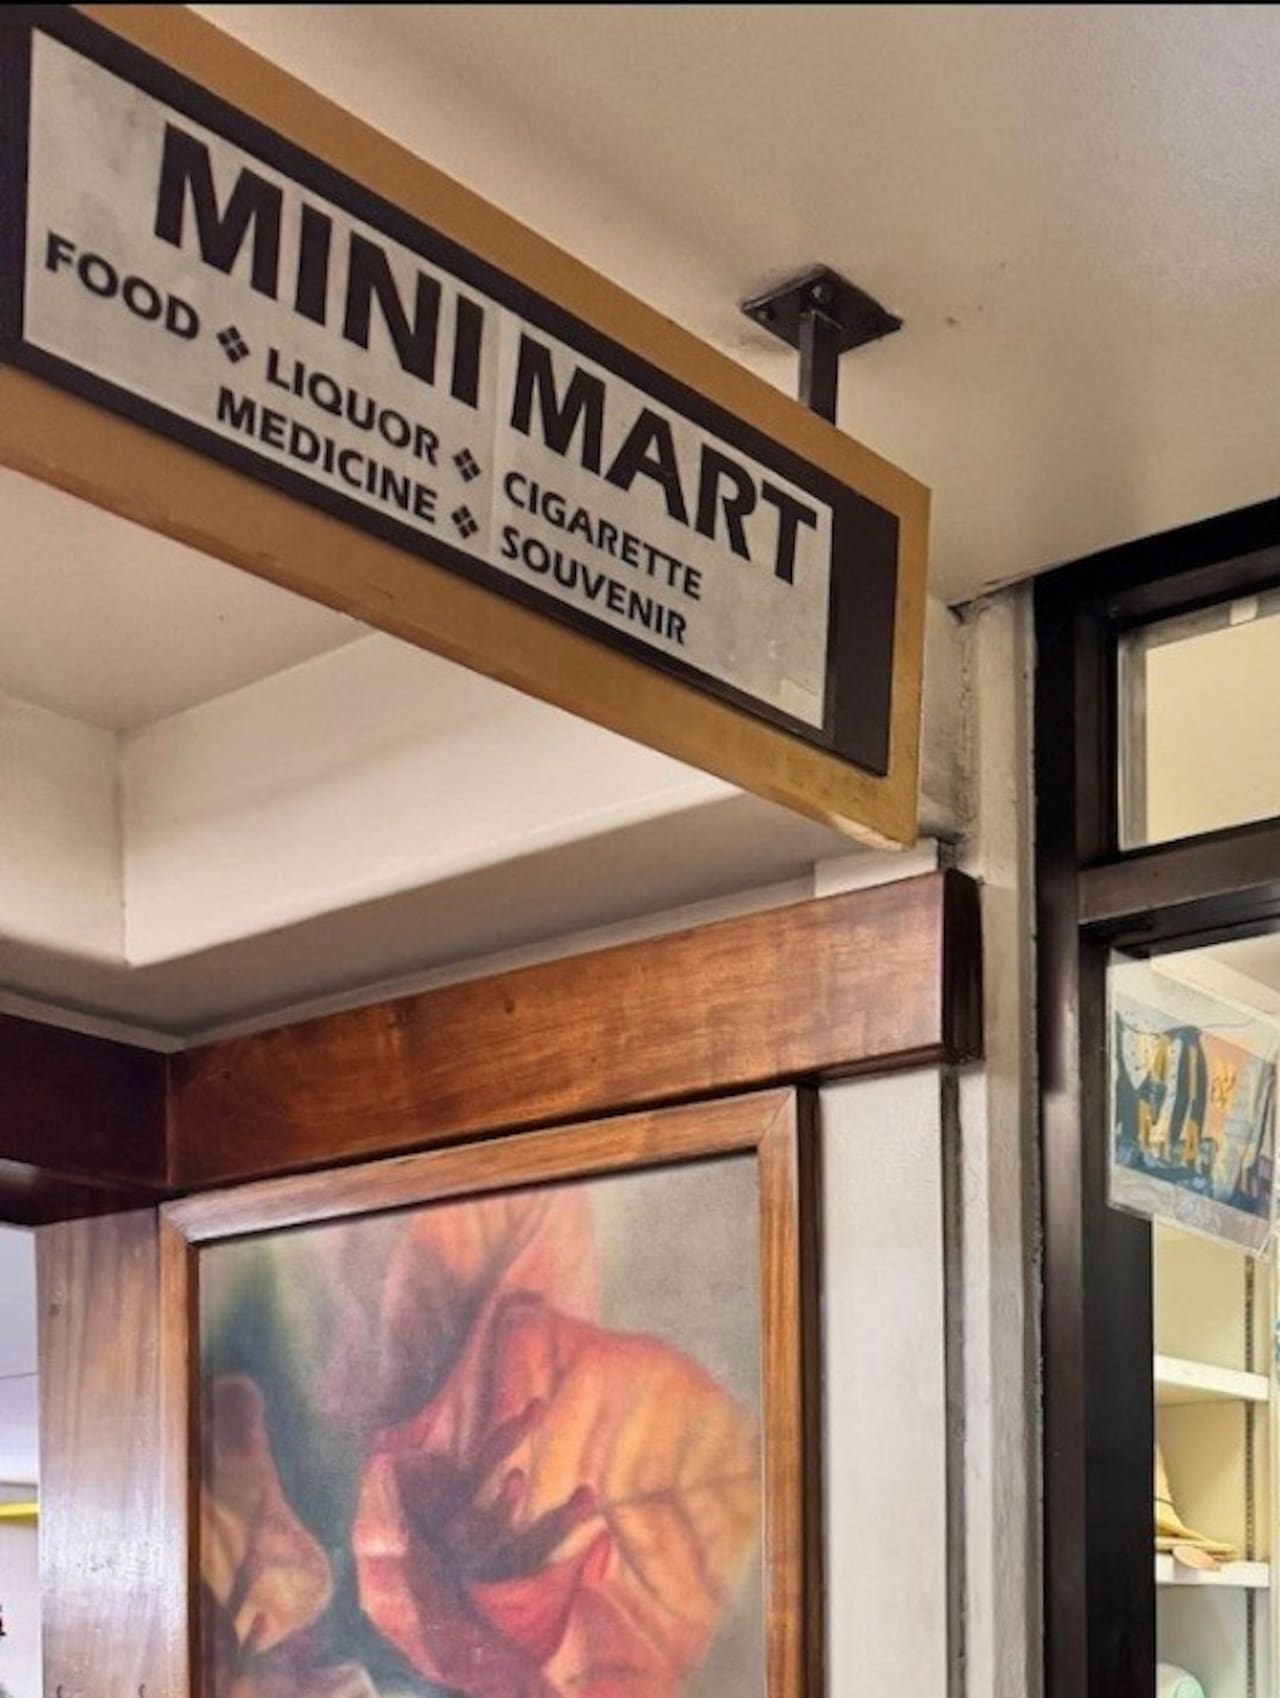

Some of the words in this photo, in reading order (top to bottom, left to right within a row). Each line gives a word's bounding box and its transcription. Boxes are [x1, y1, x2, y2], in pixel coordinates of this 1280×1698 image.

[45, 231, 201, 341] FOOD
[265, 348, 440, 467] LIQUOR
[502, 471, 703, 602] CIGARETTE
[154, 121, 486, 409] MINI
[509, 332, 818, 587] MART
[215, 385, 437, 525] MEDICINE
[500, 526, 689, 647] SOUVENIR
